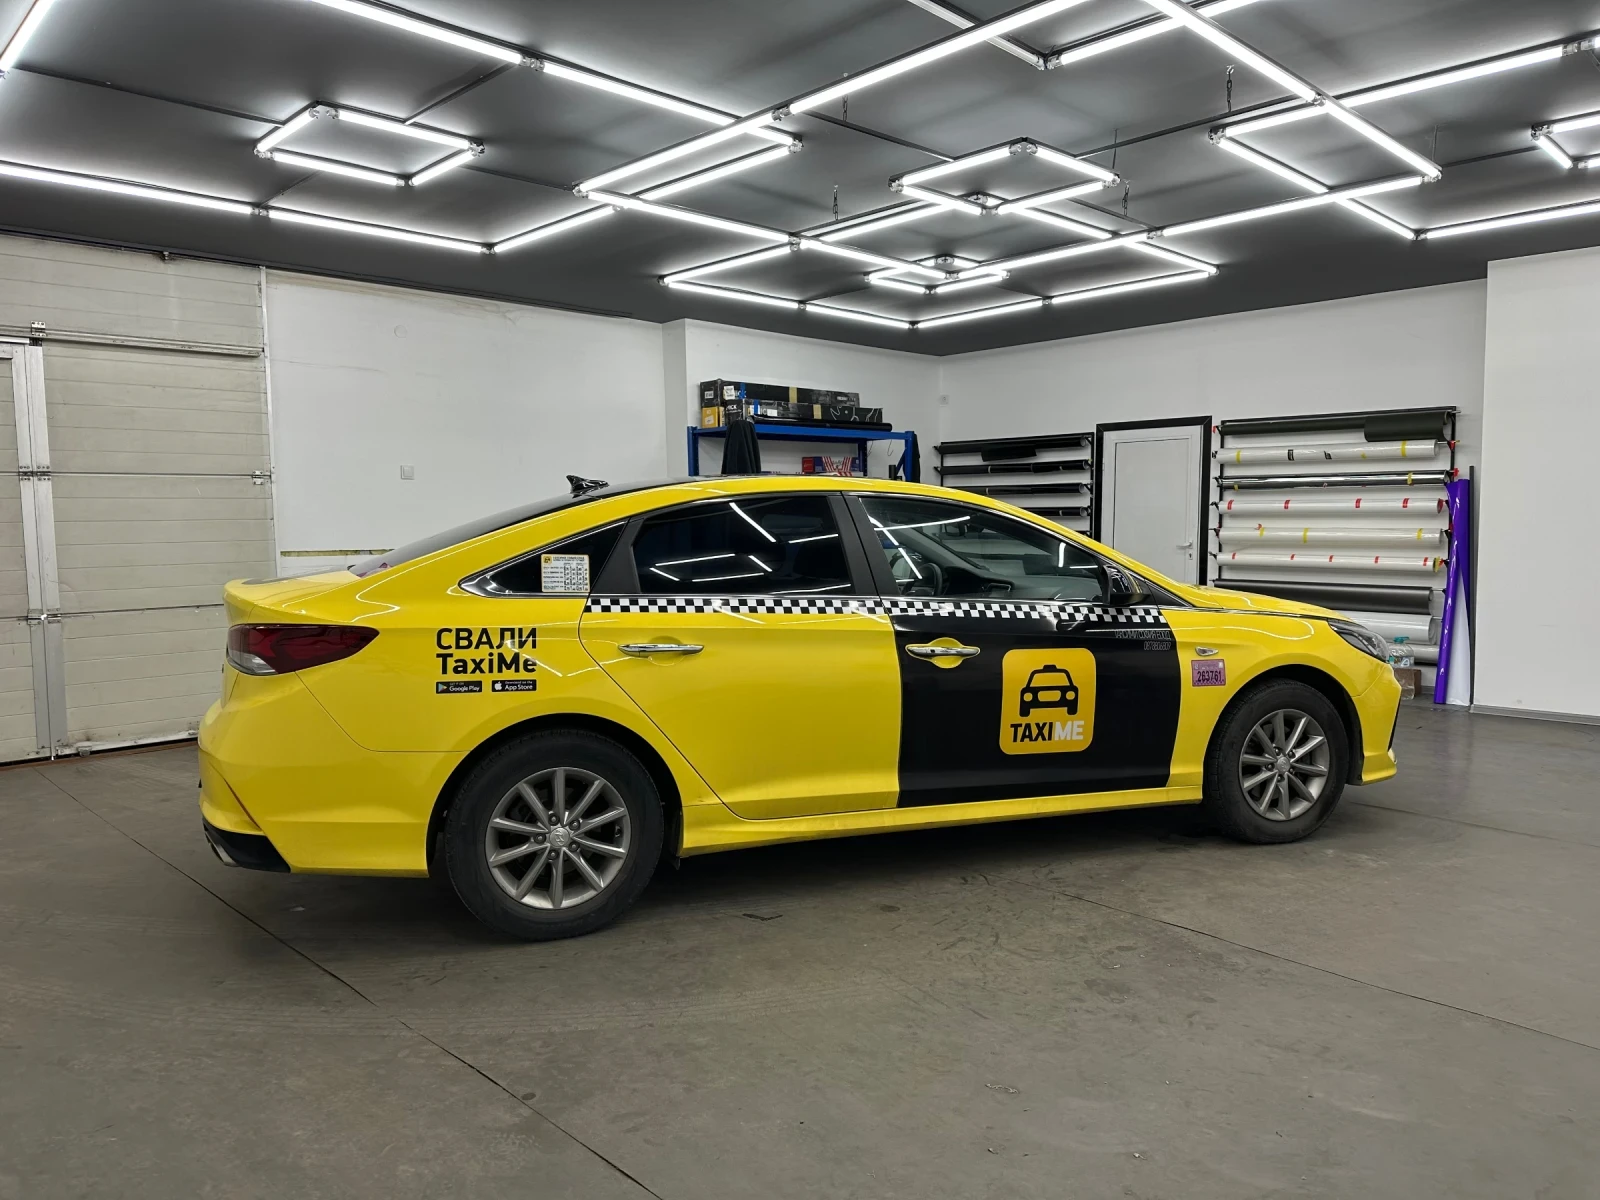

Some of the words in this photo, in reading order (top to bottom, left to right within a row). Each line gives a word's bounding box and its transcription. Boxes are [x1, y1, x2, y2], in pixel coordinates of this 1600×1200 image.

[436, 627, 537, 650] СВАЛИ
[436, 652, 537, 675] TaxiMe
[1197, 670, 1223, 683] 263761
[449, 685, 469, 693] Google
[505, 684, 517, 692] App
